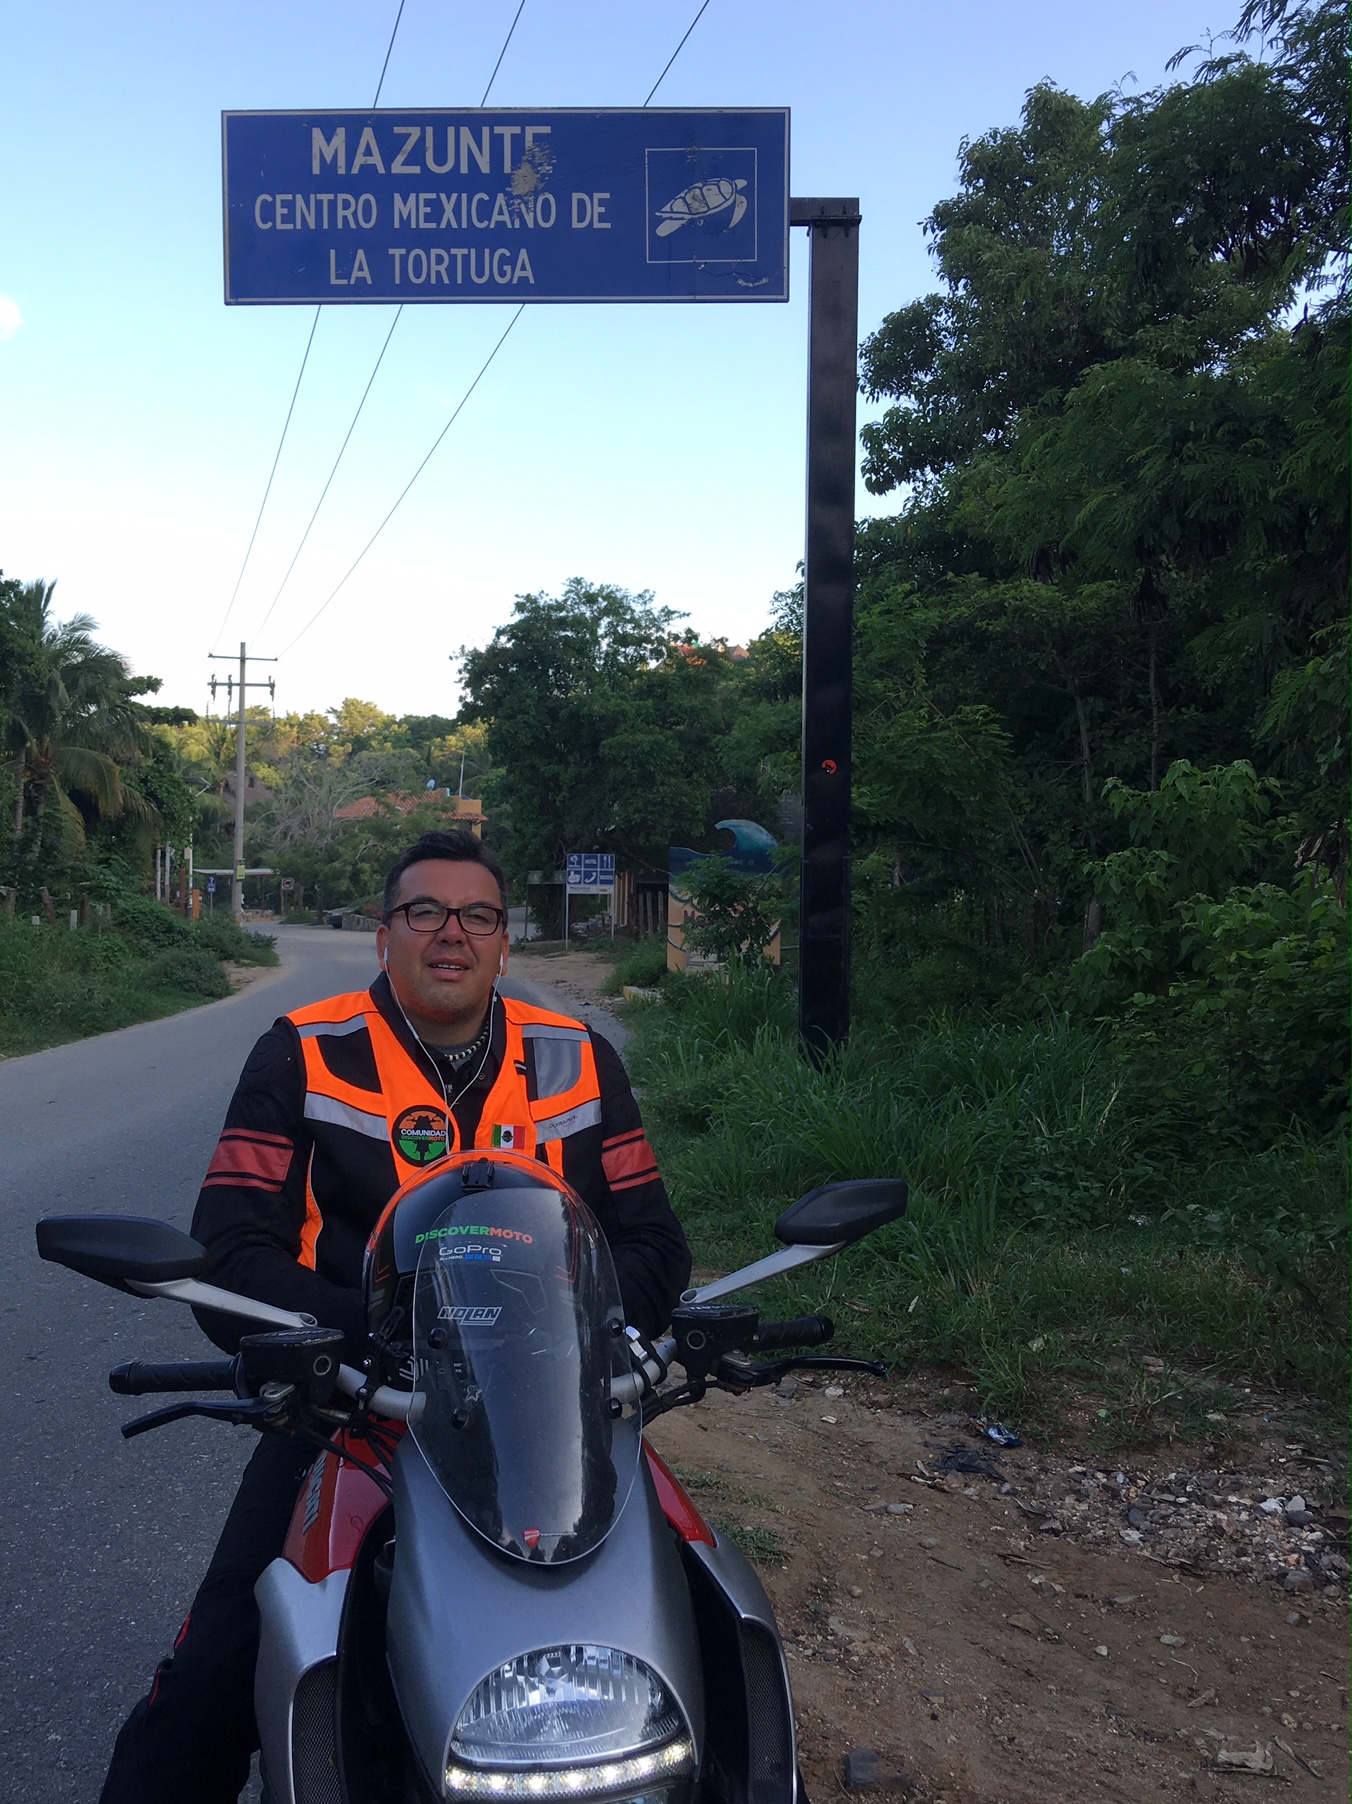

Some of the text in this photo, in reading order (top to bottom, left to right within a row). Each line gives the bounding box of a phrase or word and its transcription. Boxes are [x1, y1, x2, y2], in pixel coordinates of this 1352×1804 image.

[311, 125, 552, 175] MAZUNTE
[254, 191, 611, 230] CENTRO MEXICANO DE
[329, 247, 535, 285] LA TORTUGA
[400, 1128, 447, 1137] COMUNIDAD
[415, 1226, 533, 1244] DISCOVERMOTO
[438, 1244, 502, 1256] GoPro
[437, 1306, 503, 1326] NOLAN
